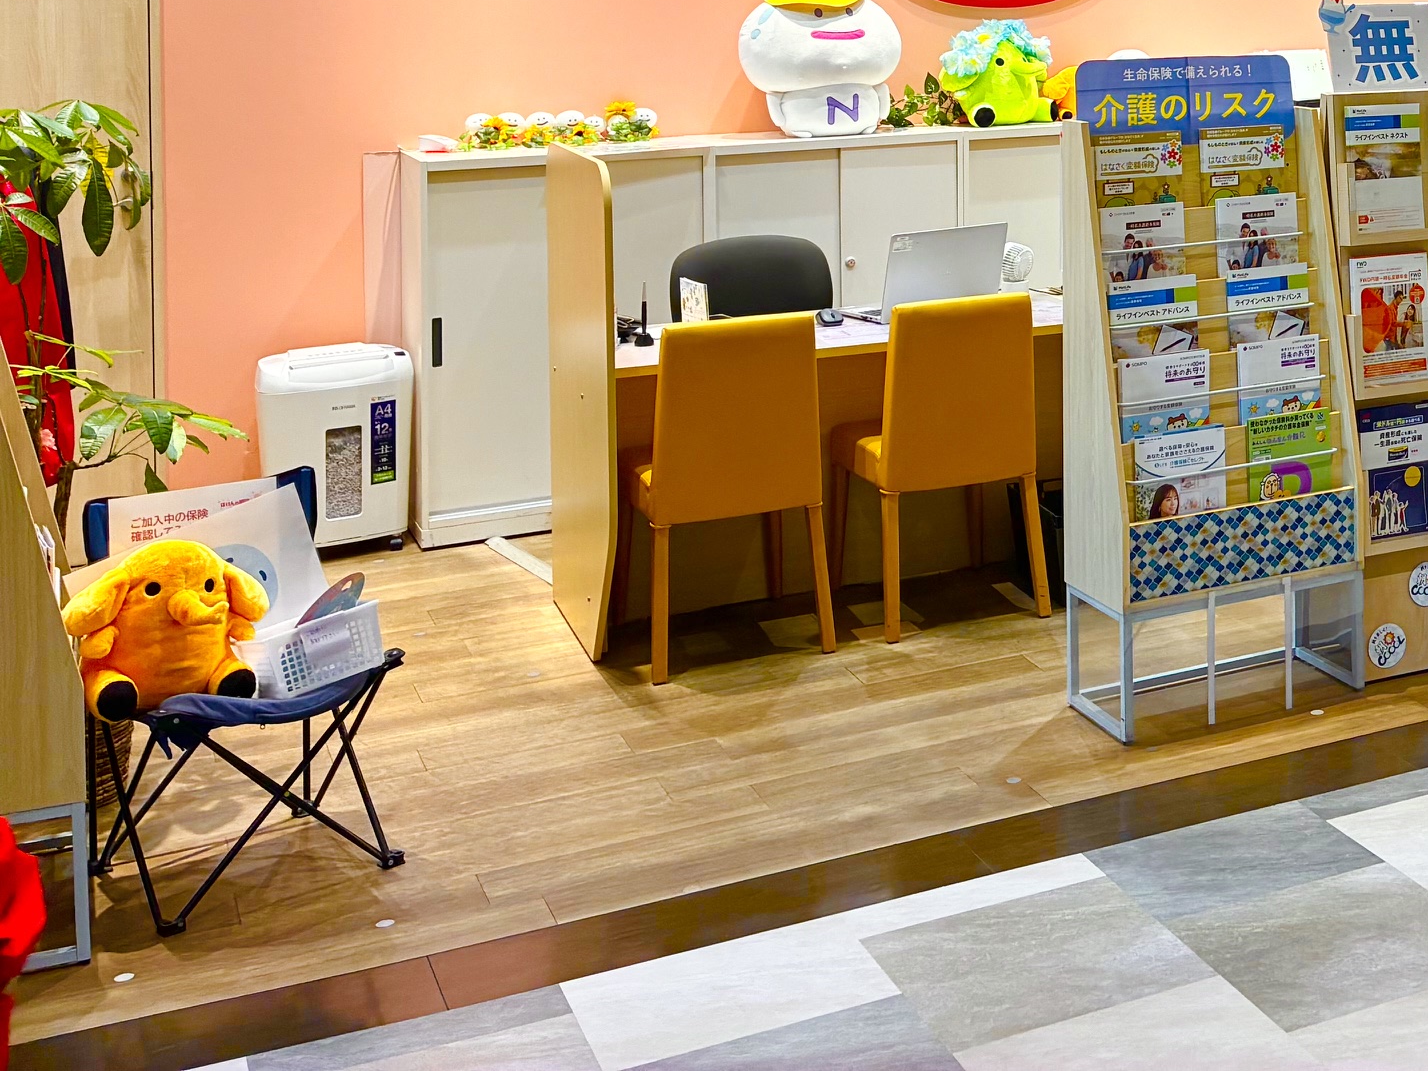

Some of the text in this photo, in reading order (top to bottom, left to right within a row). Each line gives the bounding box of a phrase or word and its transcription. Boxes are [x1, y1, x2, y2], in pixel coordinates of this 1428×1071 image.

[1122, 64, 1253, 82] 生命保険で備えられる！
[826, 92, 860, 126] N
[1093, 87, 1277, 129] 介護のリスク
[1355, 133, 1389, 142] ライフインベスト
[1235, 292, 1302, 307] ライフインベスト アドバンス
[1115, 306, 1190, 321] ライフインベスト アドバンス
[1280, 349, 1316, 360] 将来のお守り
[1165, 366, 1206, 378] 将来のお守り
[374, 403, 392, 416] A4
[374, 422, 389, 435] 12
[130, 508, 209, 529] ご加入中の保険
